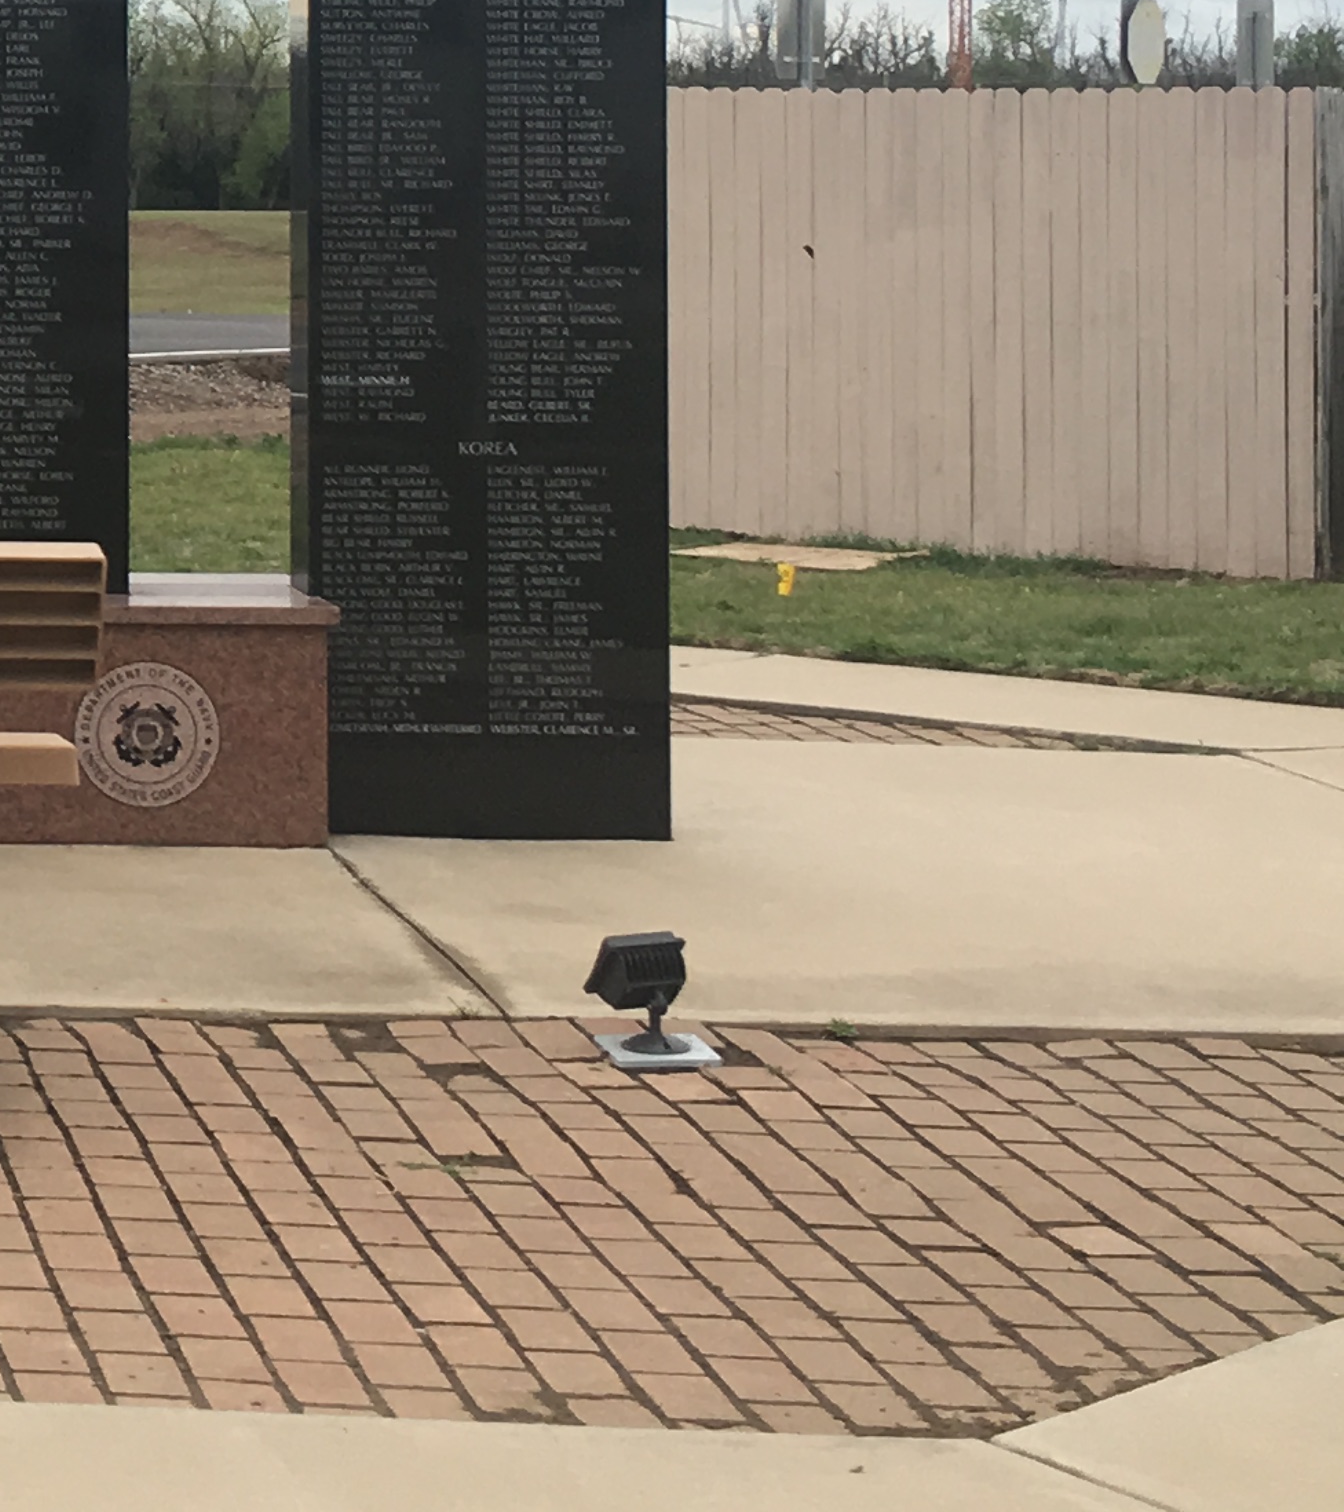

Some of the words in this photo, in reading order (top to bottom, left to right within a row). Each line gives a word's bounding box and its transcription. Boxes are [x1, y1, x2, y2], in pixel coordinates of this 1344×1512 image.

[458, 442, 518, 456] KOREA
[80, 668, 141, 731] DEPARTMENT
[148, 668, 168, 678] OF
[172, 674, 195, 696] THE
[196, 697, 214, 731] NAVY
[82, 750, 110, 784] UNITED
[108, 781, 148, 801] STATES
[150, 783, 185, 801] COAST
[188, 750, 212, 783] GUARD
